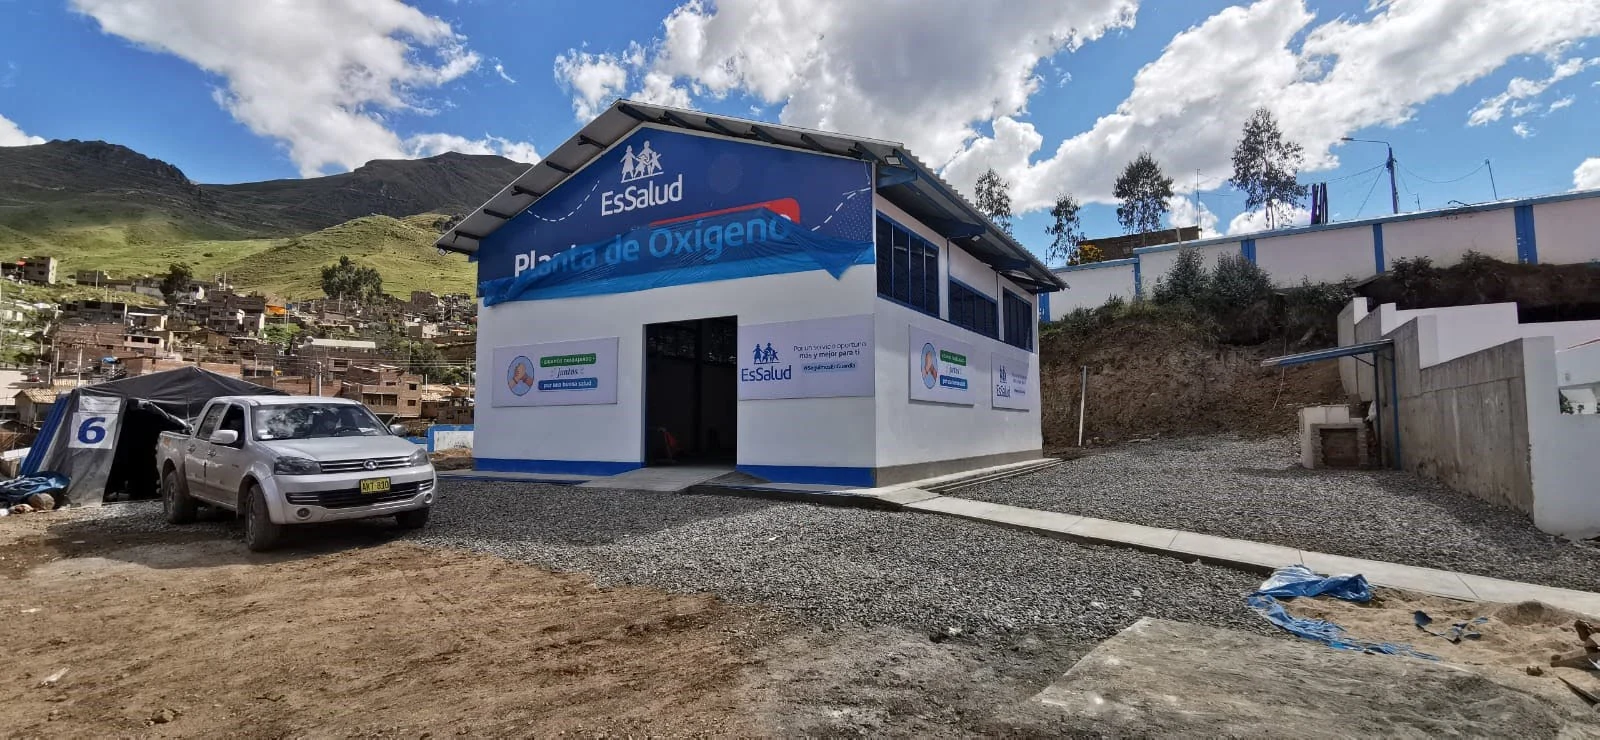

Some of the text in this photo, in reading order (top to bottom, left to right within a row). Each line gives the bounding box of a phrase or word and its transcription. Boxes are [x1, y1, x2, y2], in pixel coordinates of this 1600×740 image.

[601, 174, 683, 216] EsSalud
[605, 234, 640, 264] de
[741, 365, 792, 381] EsSalud
[78, 417, 106, 444] 6
